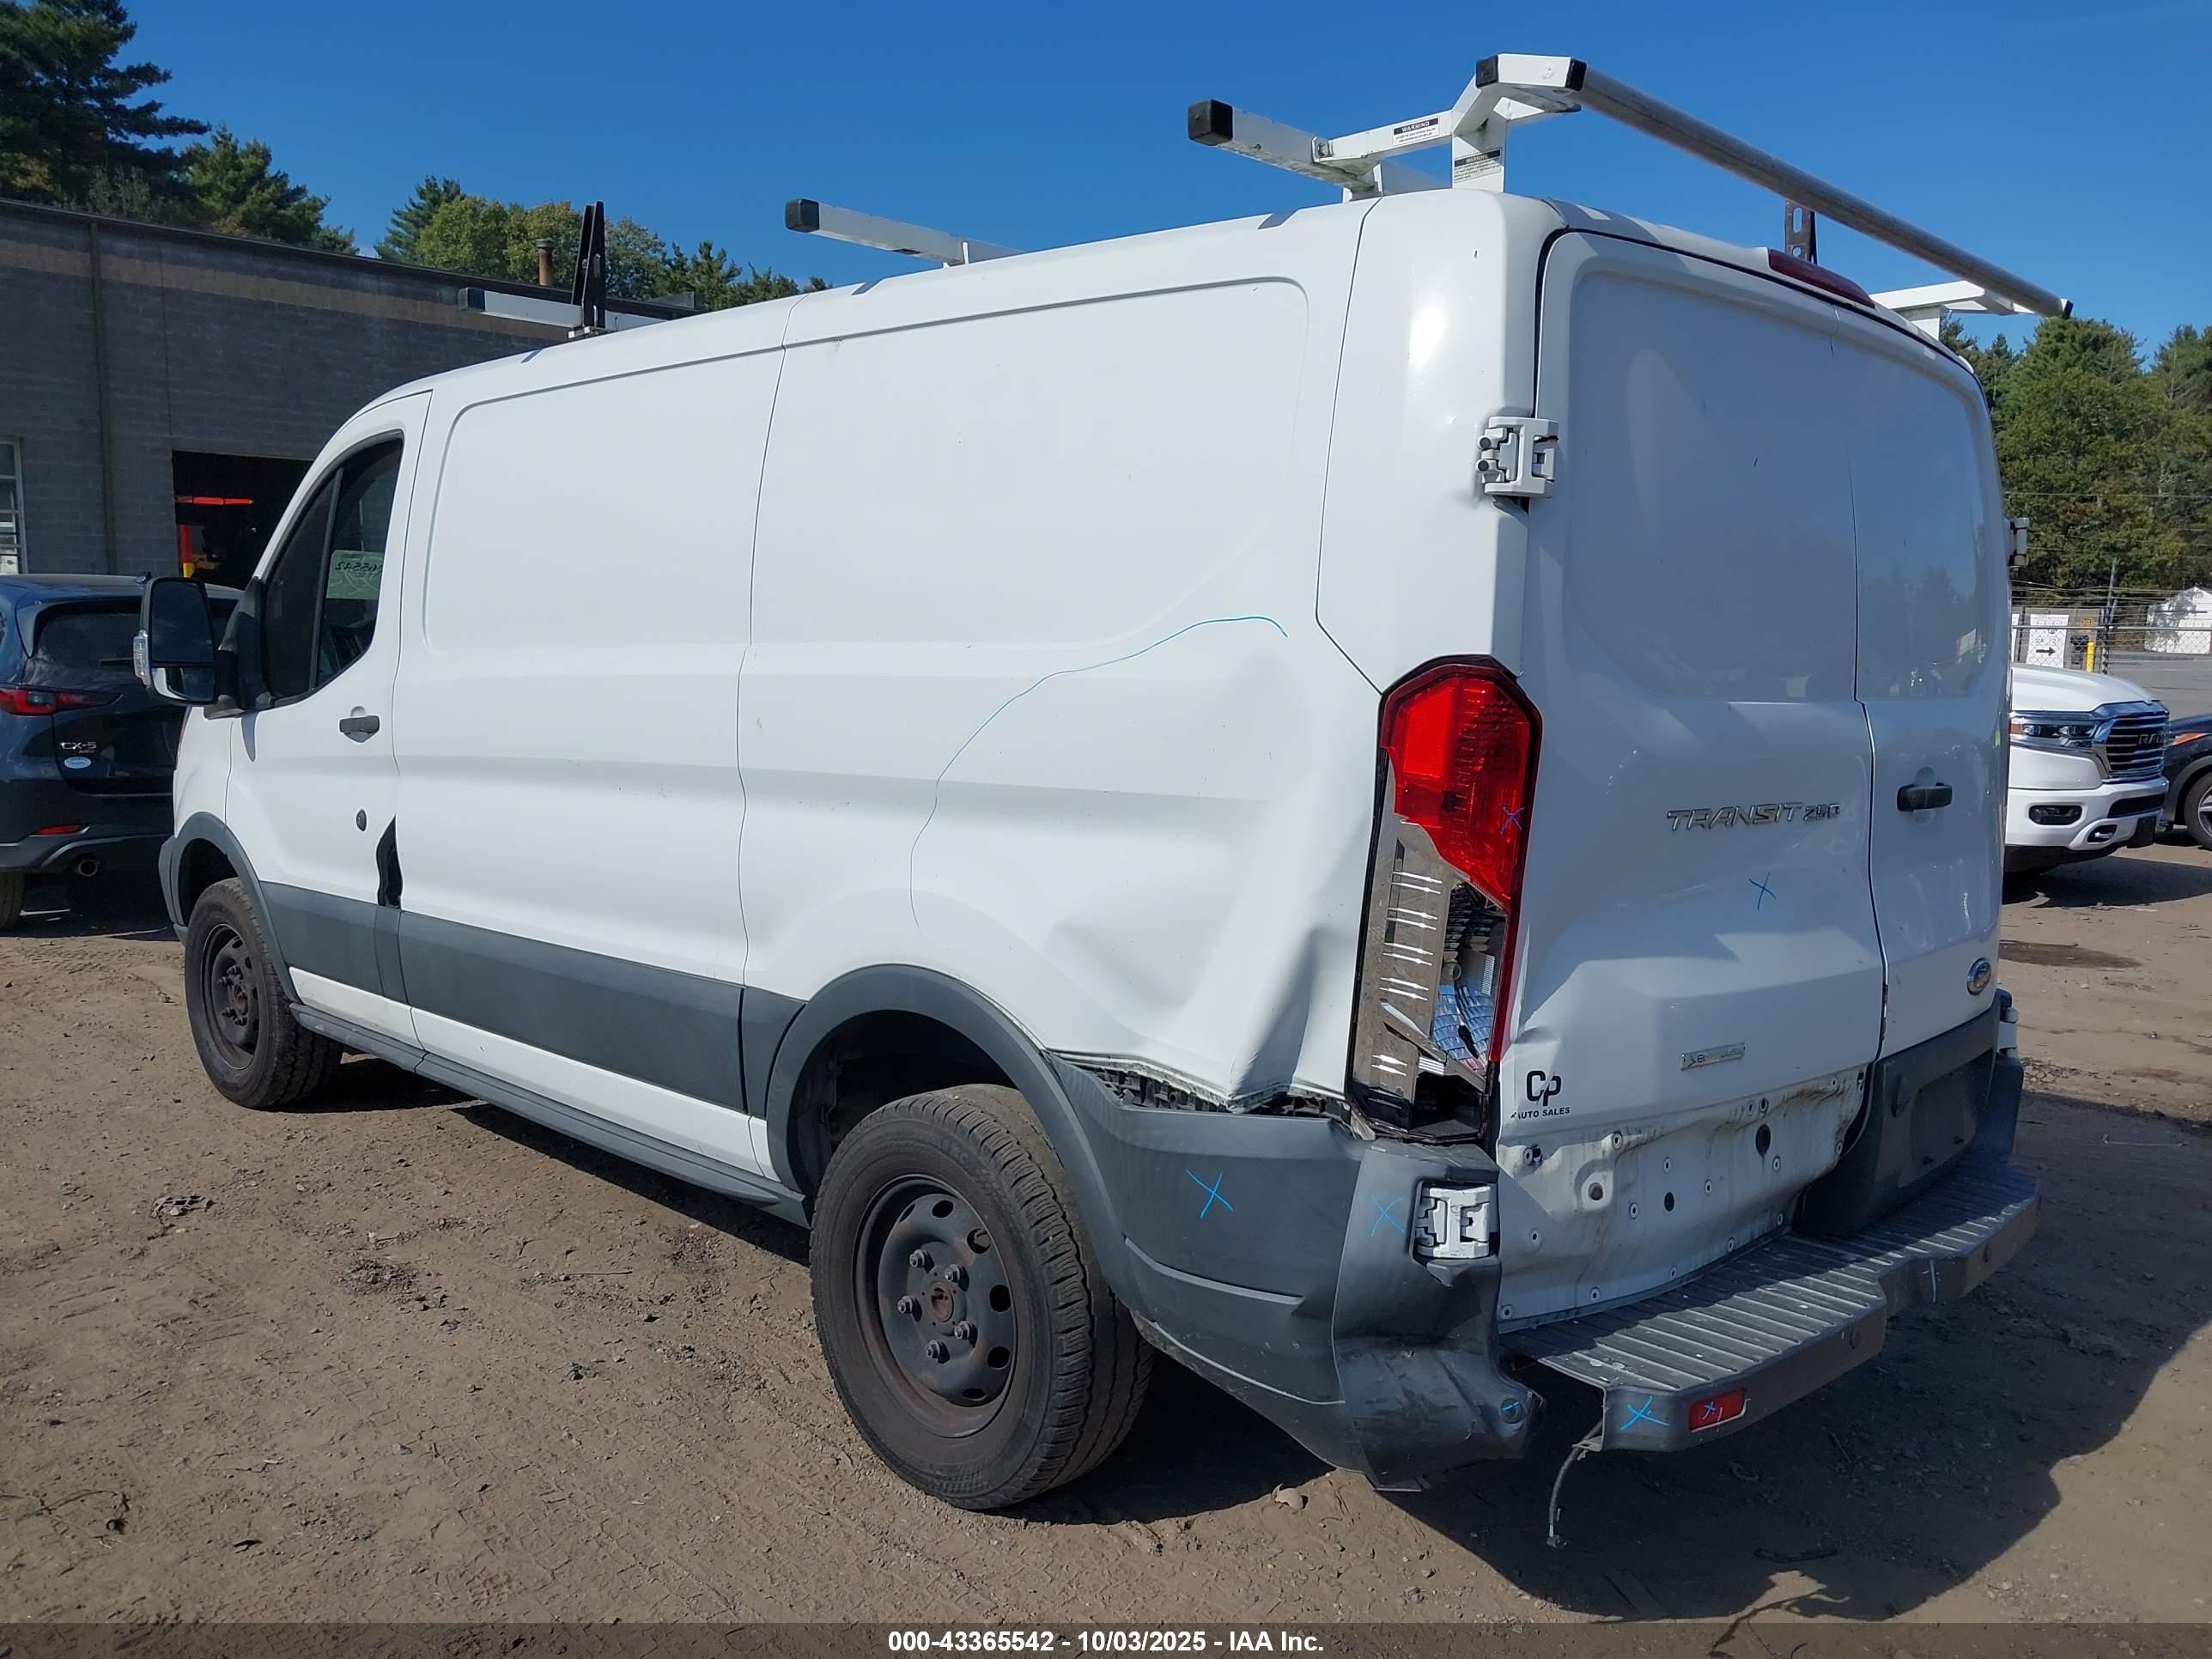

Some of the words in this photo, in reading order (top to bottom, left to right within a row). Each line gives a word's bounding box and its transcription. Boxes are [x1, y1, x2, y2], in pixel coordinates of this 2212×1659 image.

[1401, 121, 1430, 132] WARNING
[59, 741, 97, 750] CX-5
[1667, 802, 1802, 831] TRANSIT
[1510, 1109, 1540, 1120] AUTO
[1541, 1106, 1571, 1117] SALES
